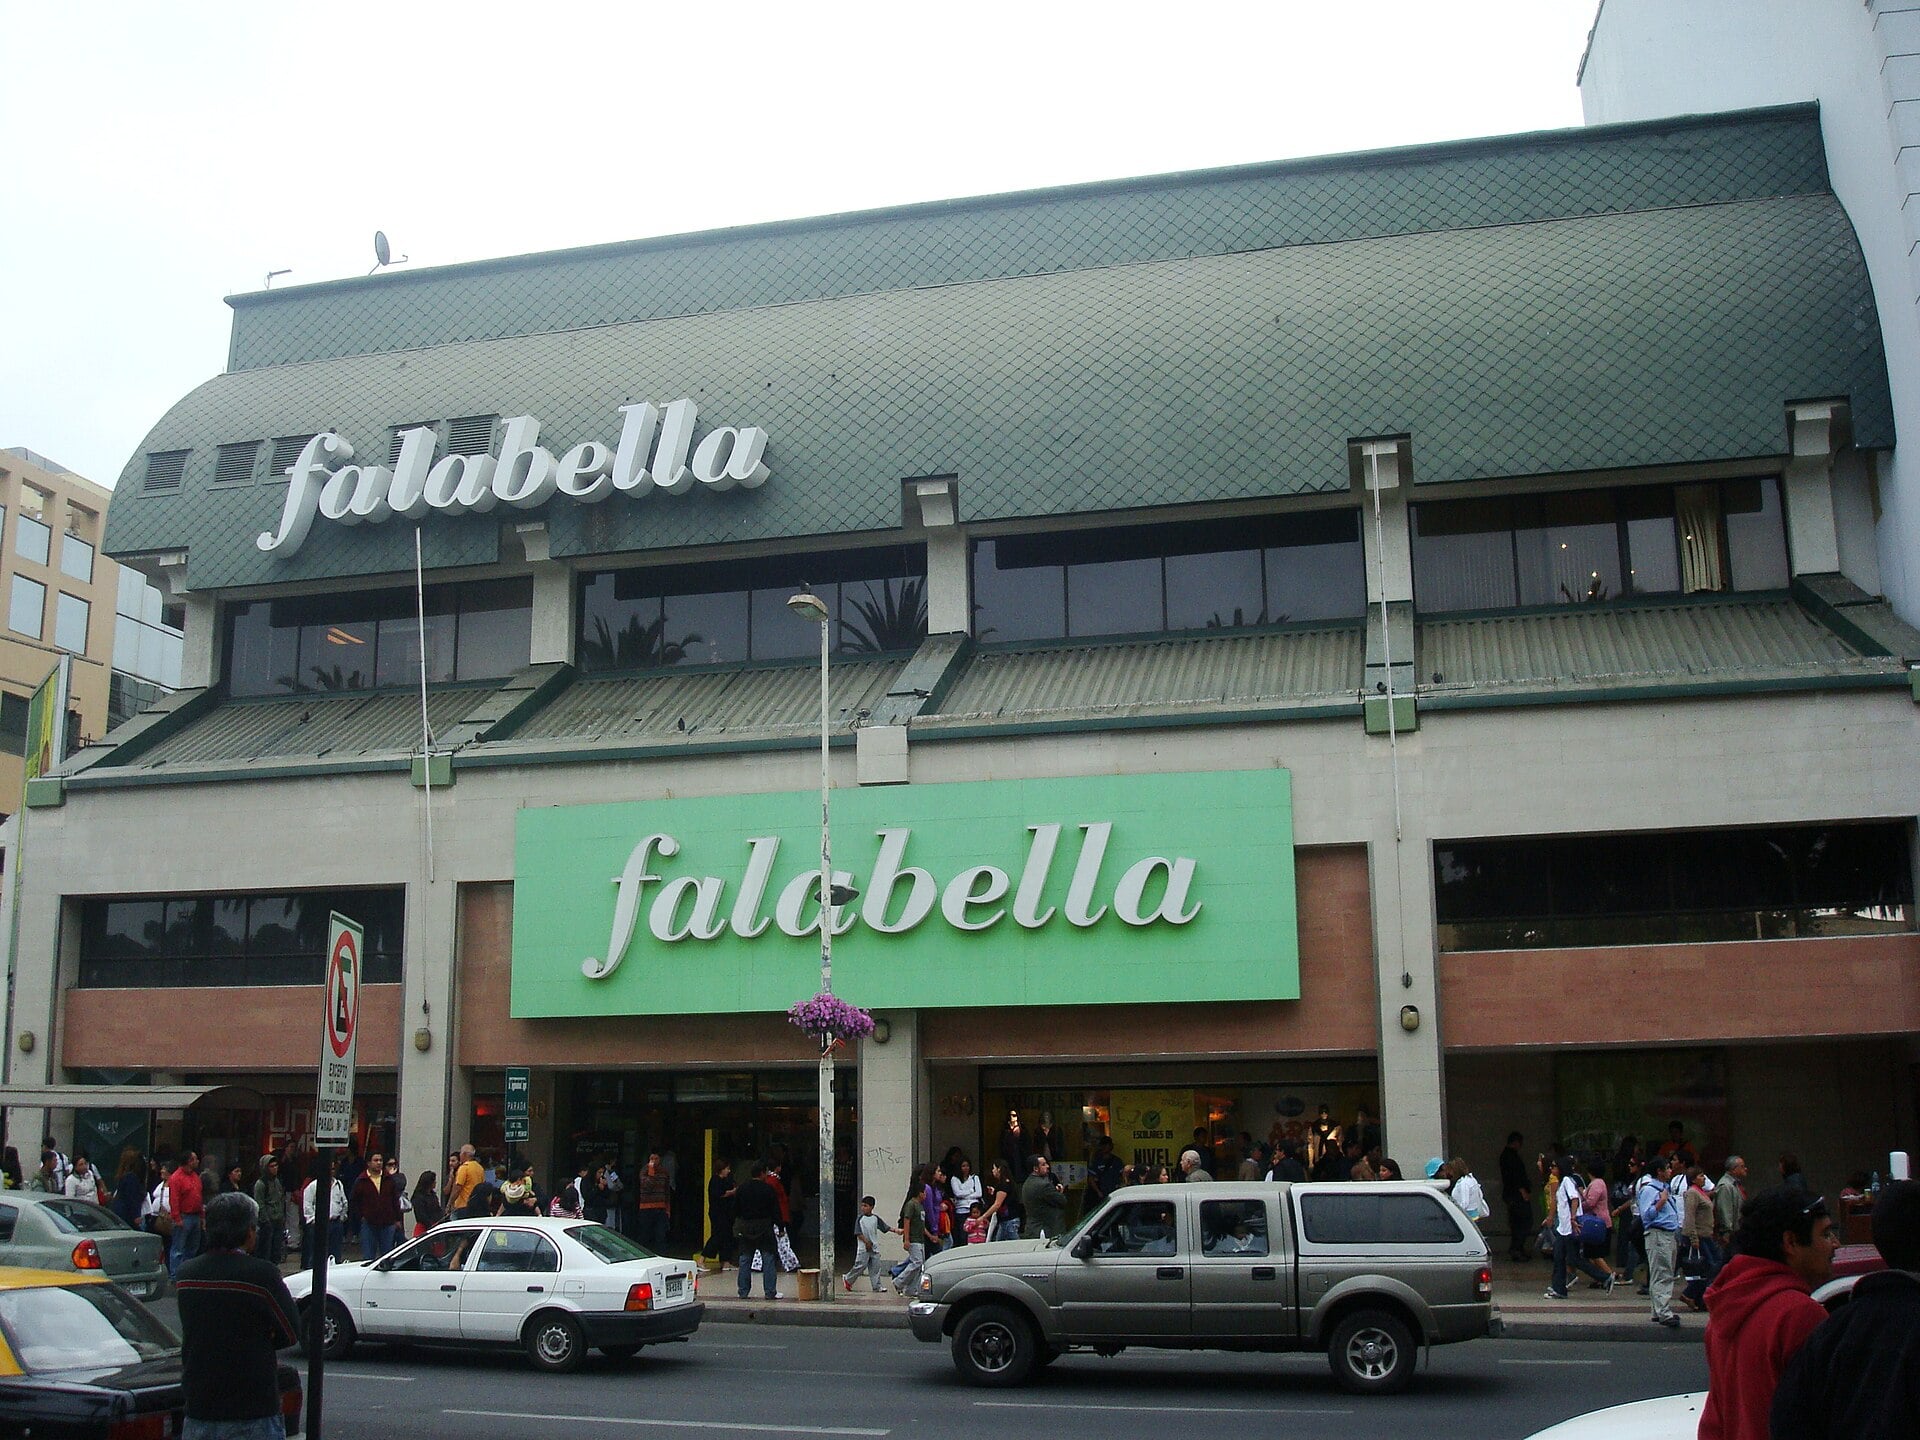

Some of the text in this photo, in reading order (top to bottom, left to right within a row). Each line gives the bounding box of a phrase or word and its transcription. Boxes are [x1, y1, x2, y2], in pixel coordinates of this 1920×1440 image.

[257, 398, 770, 555] falabella
[581, 821, 1203, 980] falabella
[328, 1062, 348, 1079] EXCEPTO
[507, 1101, 527, 1111] PARADA
[1132, 1130, 1164, 1140] ESCOLARES
[1133, 1148, 1174, 1167] NIVEL
